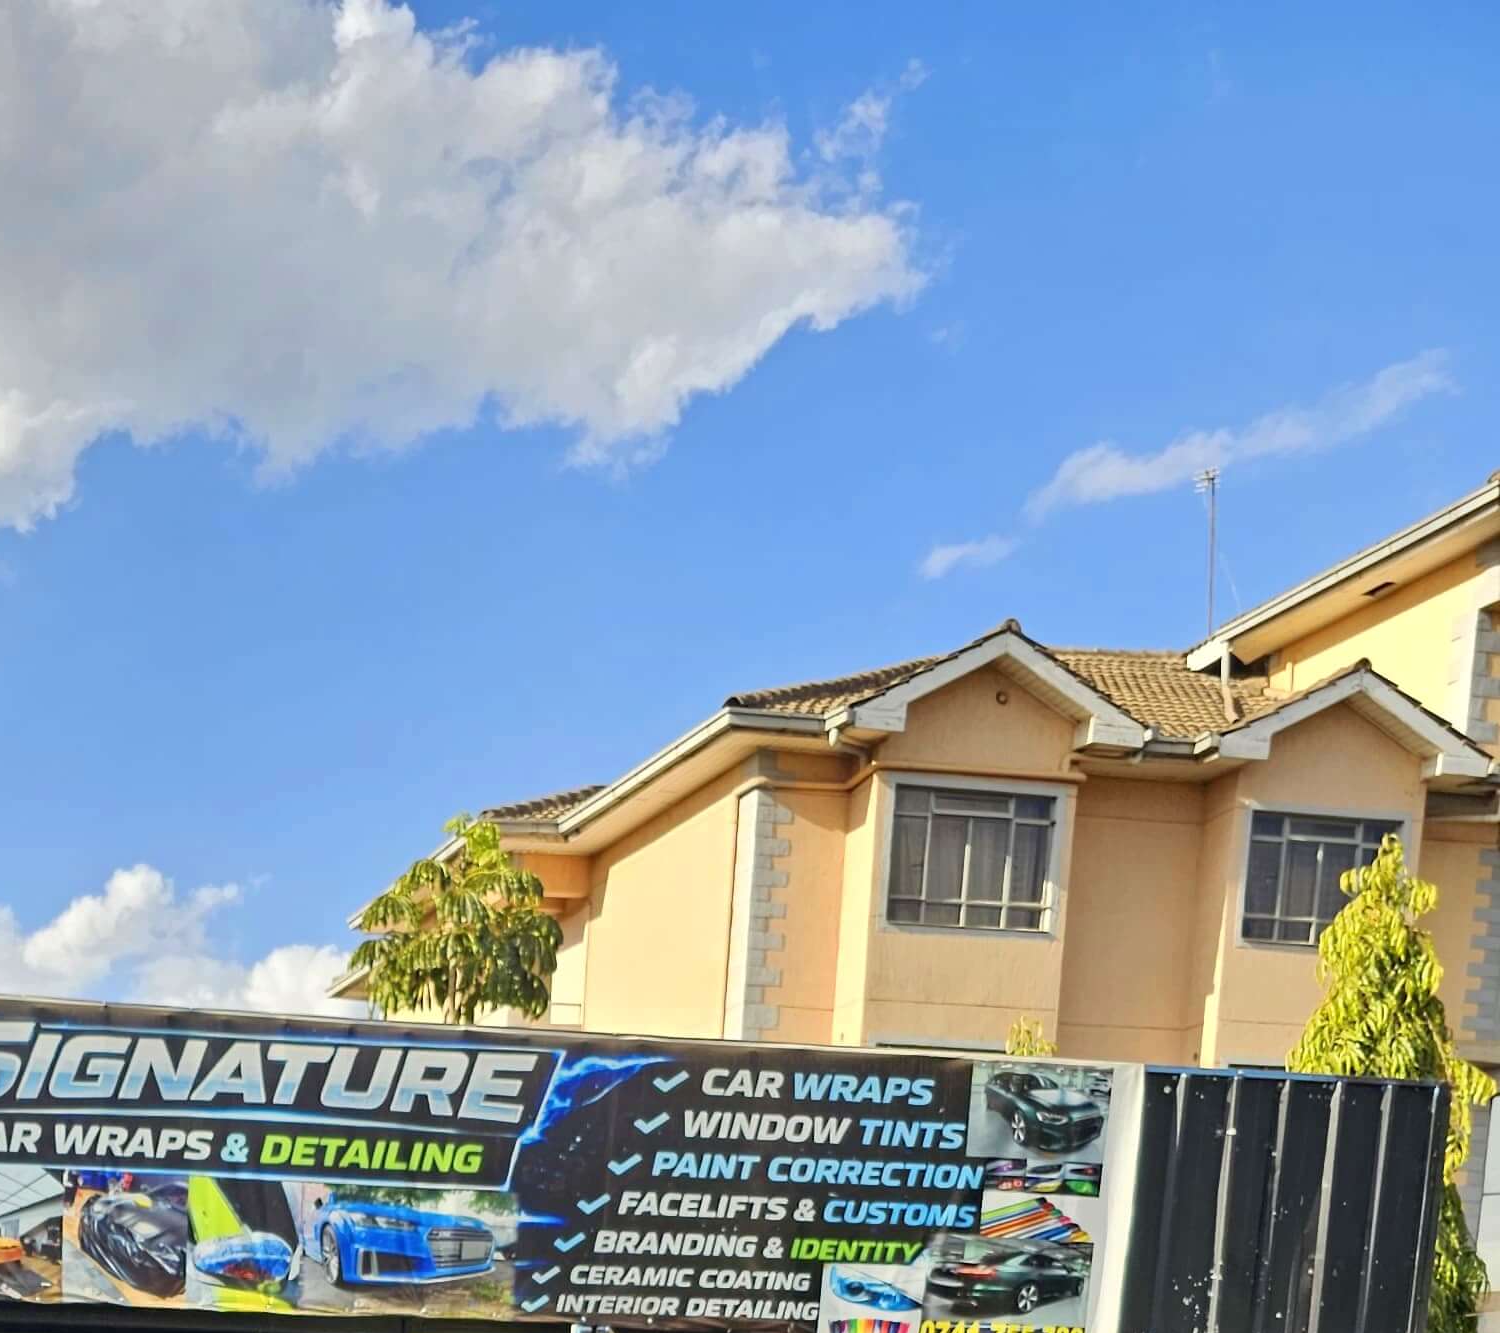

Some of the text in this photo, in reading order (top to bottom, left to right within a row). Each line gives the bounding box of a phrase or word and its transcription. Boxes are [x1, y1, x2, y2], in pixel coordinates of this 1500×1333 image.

[701, 1067, 935, 1107] CAR WRAPS
[53, 1122, 214, 1161] WRAPS
[220, 1133, 249, 1164] &
[259, 1135, 484, 1175] DETAILING
[682, 1110, 966, 1150] WINDOW TINTS
[651, 1151, 984, 1190] PAINT CORRECTION
[617, 1190, 977, 1229] FACELIFTS & CUSTOMS
[593, 1231, 923, 1265] BRANDING & IDENTITY
[569, 1264, 811, 1293] CERAMIC COATING
[555, 1293, 819, 1322] INTERIOR DETAILING
